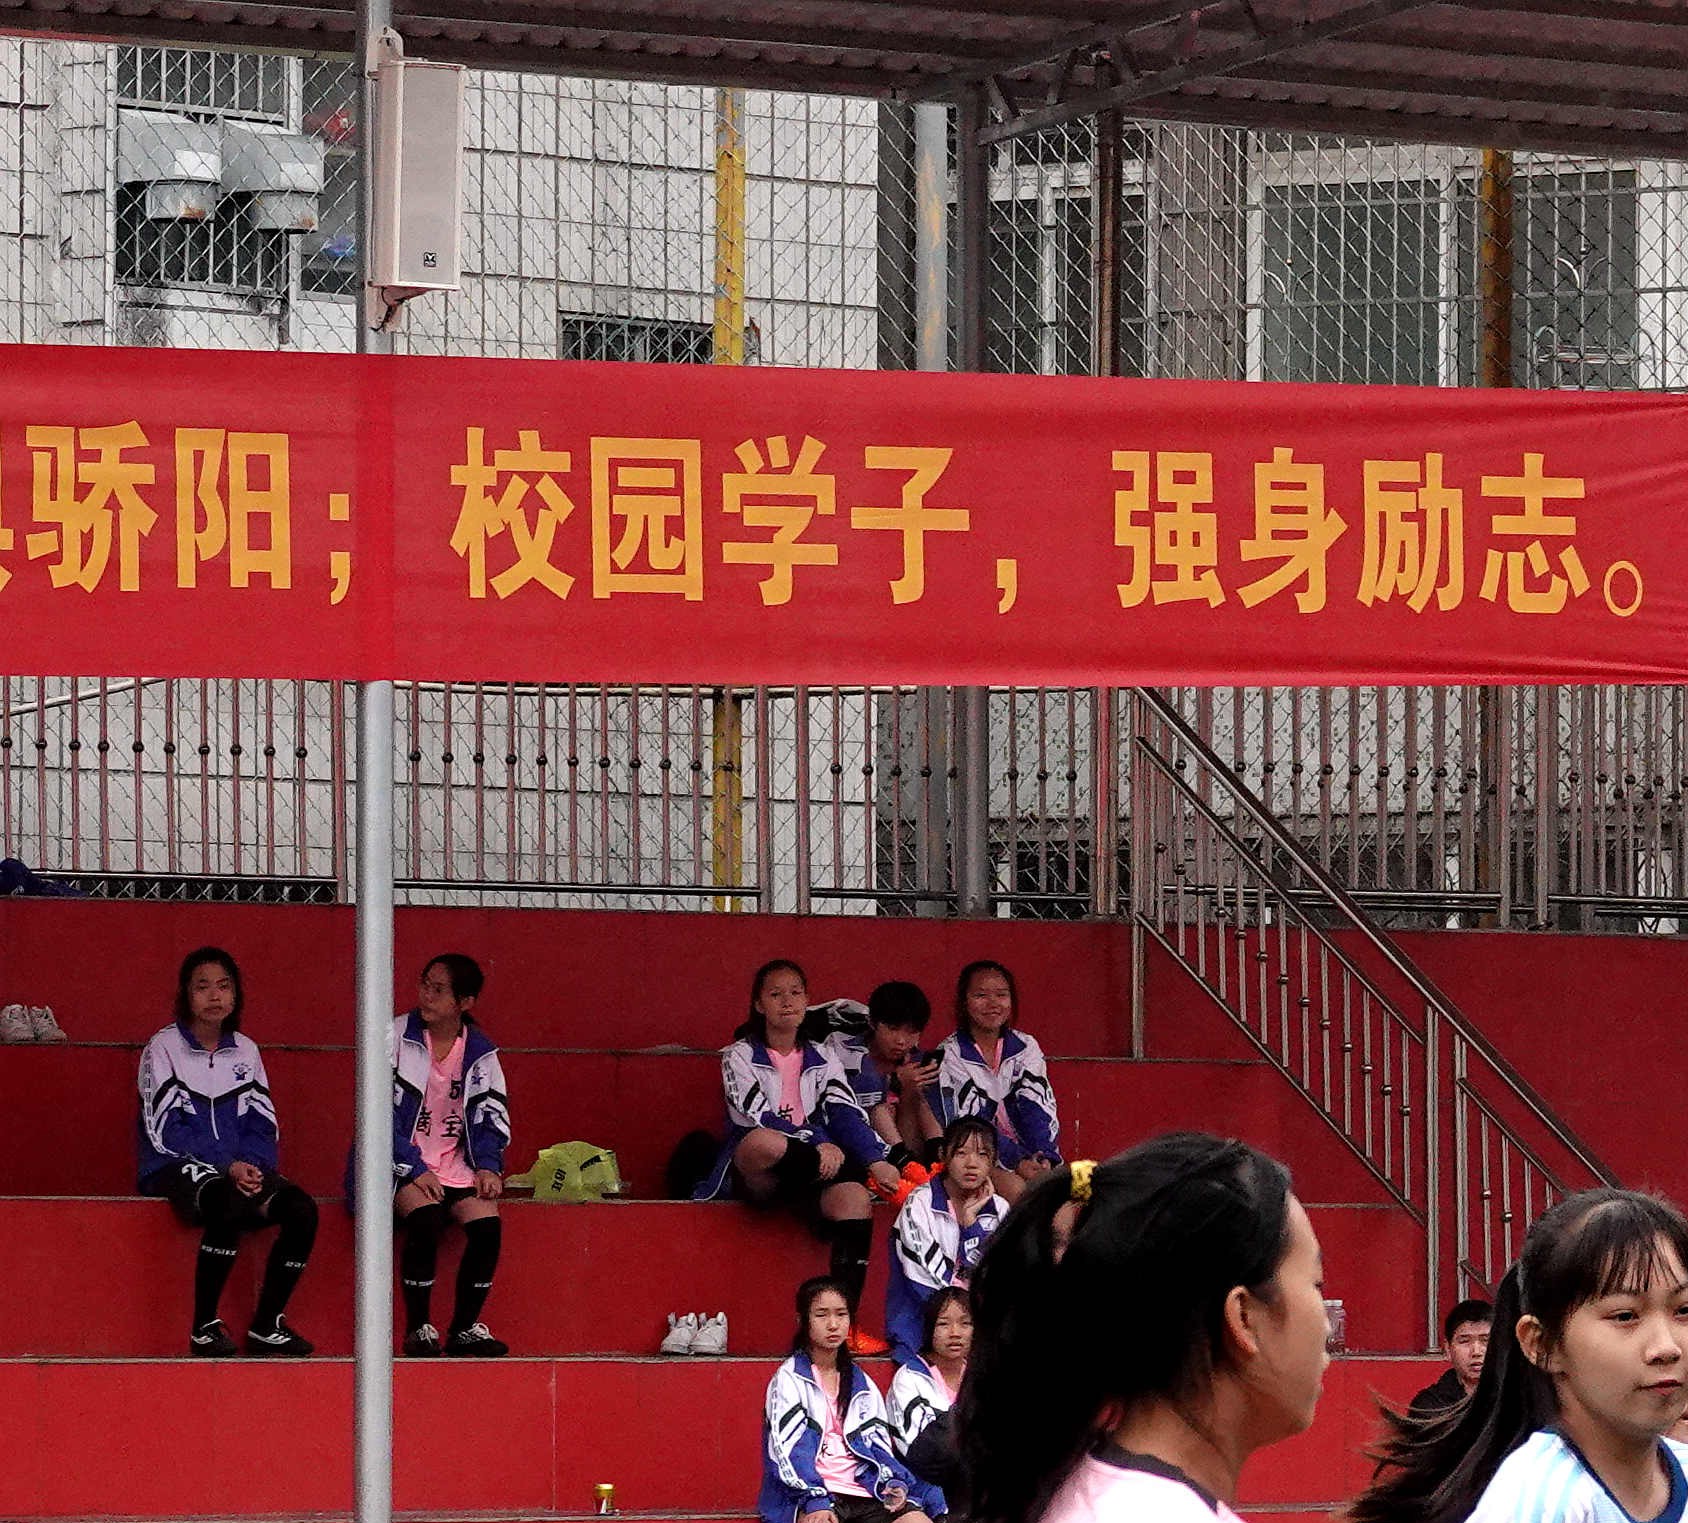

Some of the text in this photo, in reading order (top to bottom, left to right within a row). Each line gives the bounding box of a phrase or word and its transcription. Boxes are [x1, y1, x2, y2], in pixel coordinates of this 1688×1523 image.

[0, 421, 1643, 617] 骄阳；校园学子，强身励志。
